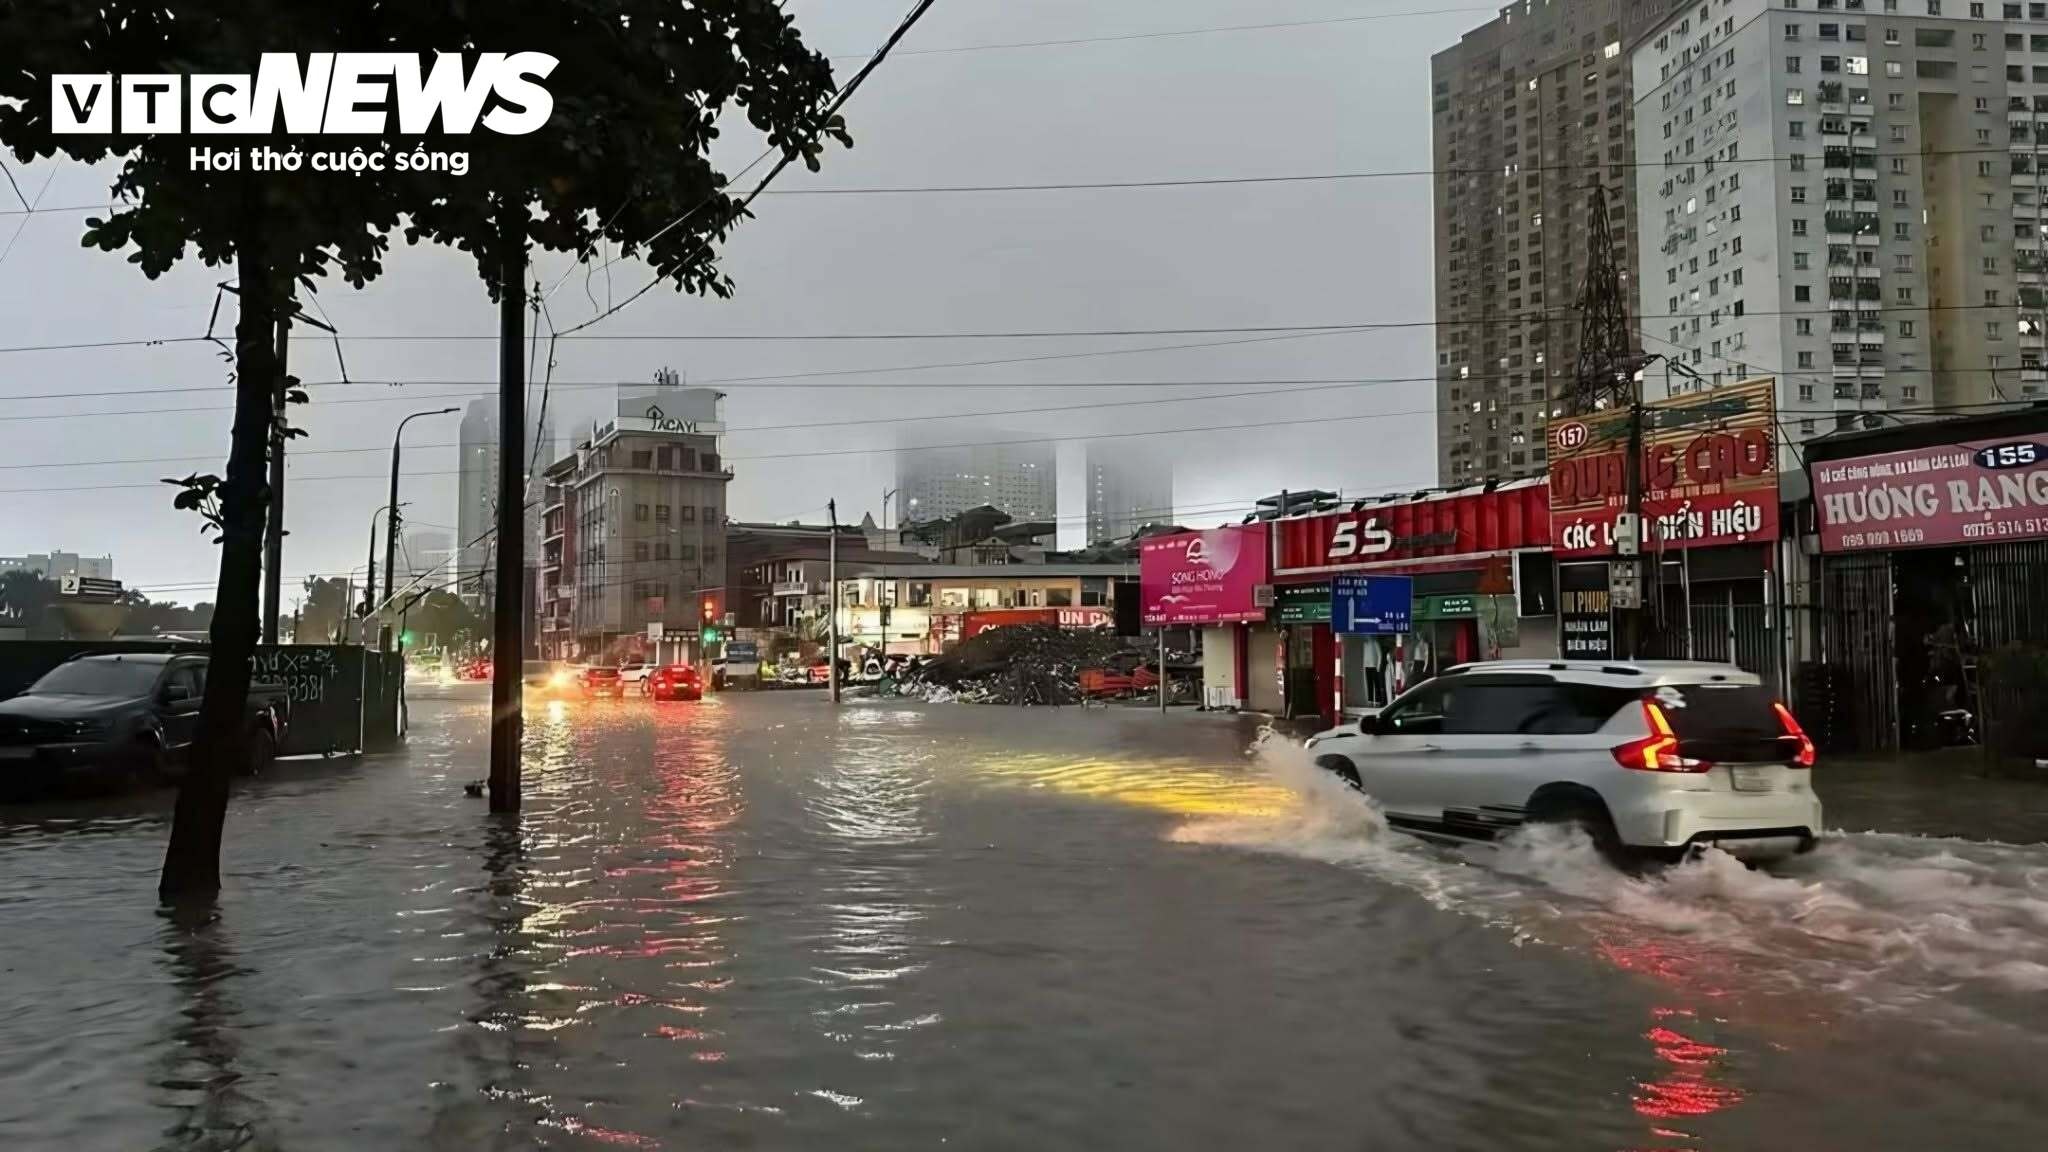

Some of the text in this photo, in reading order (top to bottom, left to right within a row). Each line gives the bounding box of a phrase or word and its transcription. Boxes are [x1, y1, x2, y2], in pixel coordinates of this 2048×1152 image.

[1560, 426, 1583, 446] 157
[1981, 444, 2036, 467] 155
[1823, 481, 1939, 525] HƯƠNG
[1562, 517, 1597, 550] CÁC
[1603, 517, 1648, 546] LI
[1711, 500, 1762, 541] HIỆU
